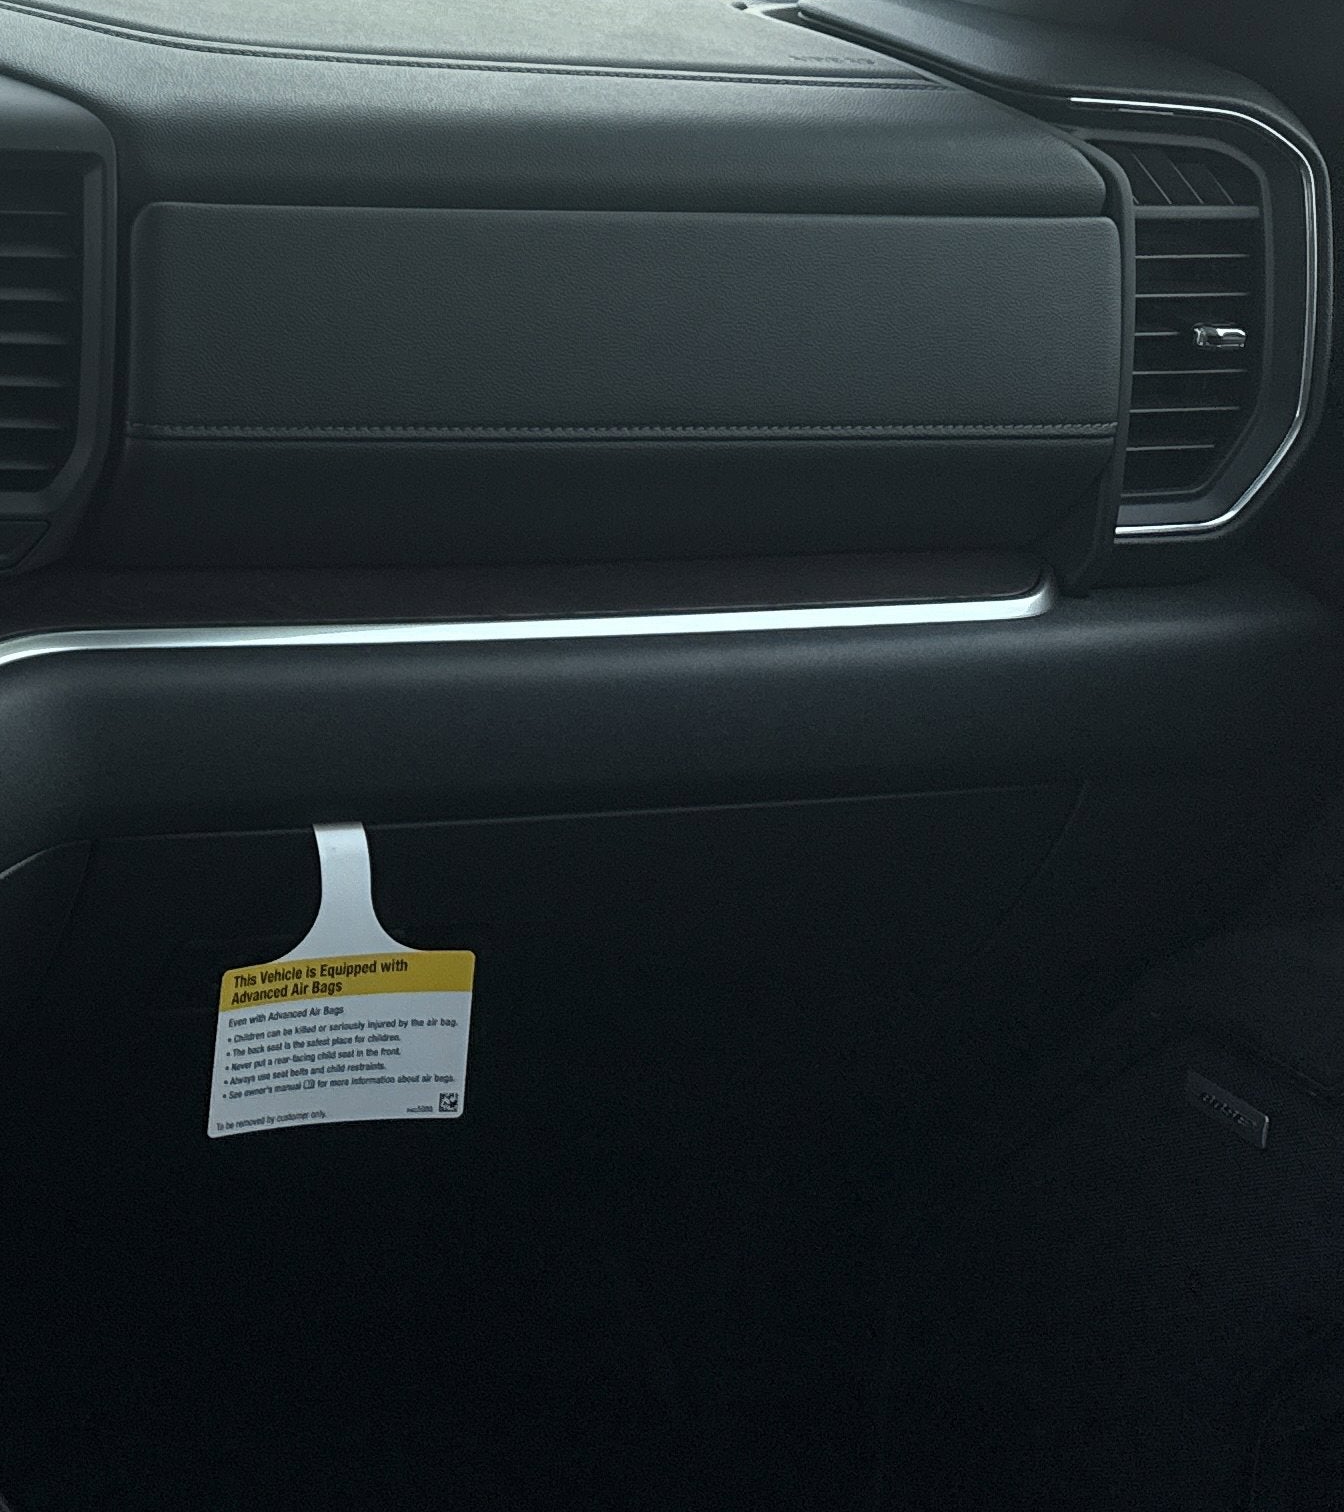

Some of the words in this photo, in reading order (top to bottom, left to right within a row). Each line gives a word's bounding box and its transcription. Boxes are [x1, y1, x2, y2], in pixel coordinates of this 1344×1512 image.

[234, 975, 257, 988] This
[260, 969, 302, 985] Vehicle
[305, 965, 316, 978] is
[320, 960, 377, 978] Equipped
[380, 958, 408, 972] with
[232, 985, 288, 1005] Advanced
[291, 982, 309, 996] Air
[312, 981, 343, 995] Bags
[229, 1018, 248, 1028] Even
[249, 1013, 266, 1024] with
[268, 1009, 307, 1021] Advanced
[309, 1007, 321, 1017] Air
[323, 1005, 344, 1016] Bags
[234, 1032, 265, 1043] Children
[267, 1030, 281, 1038] can
[283, 1028, 293, 1036] be
[295, 1025, 317, 1035] killed
[318, 1025, 327, 1033] or
[368, 1019, 396, 1030] injured
[398, 1019, 408, 1028] by
[411, 1018, 424, 1027] the
[427, 1017, 438, 1027] air
[440, 1018, 458, 1028] bag.
[233, 1048, 246, 1057] The
[248, 1045, 265, 1055] back
[267, 1042, 282, 1052] seat
[284, 1041, 291, 1050] is
[293, 1040, 305, 1049] the
[307, 1037, 330, 1047] safest
[332, 1037, 352, 1047] place
[355, 1035, 365, 1043] for
[368, 1034, 400, 1043] children.
[232, 1062, 252, 1071] Never
[254, 1059, 266, 1069] put
[274, 1053, 316, 1065] rear-facing
[317, 1050, 337, 1060] child
[338, 1049, 354, 1058] seat
[357, 1048, 364, 1057] in
[366, 1048, 379, 1056] the
[381, 1047, 401, 1056] front.
[230, 1075, 255, 1085] Always
[258, 1073, 271, 1081] use
[273, 1070, 289, 1079] seat
[290, 1068, 309, 1077] belts
[311, 1066, 325, 1074] and
[327, 1064, 346, 1073] child
[348, 1061, 387, 1071] restraints.
[229, 1090, 243, 1099] See
[274, 1081, 302, 1092] manual
[317, 1079, 328, 1088] for
[330, 1078, 349, 1087] more
[352, 1075, 396, 1085] information
[397, 1074, 420, 1084] about
[422, 1073, 433, 1083] air
[434, 1074, 455, 1084] bags.
[217, 1122, 224, 1131] To
[226, 1121, 234, 1129] be
[236, 1117, 265, 1128] removed
[267, 1115, 275, 1124] by
[276, 1111, 309, 1122] customer
[311, 1110, 327, 1119] only.
